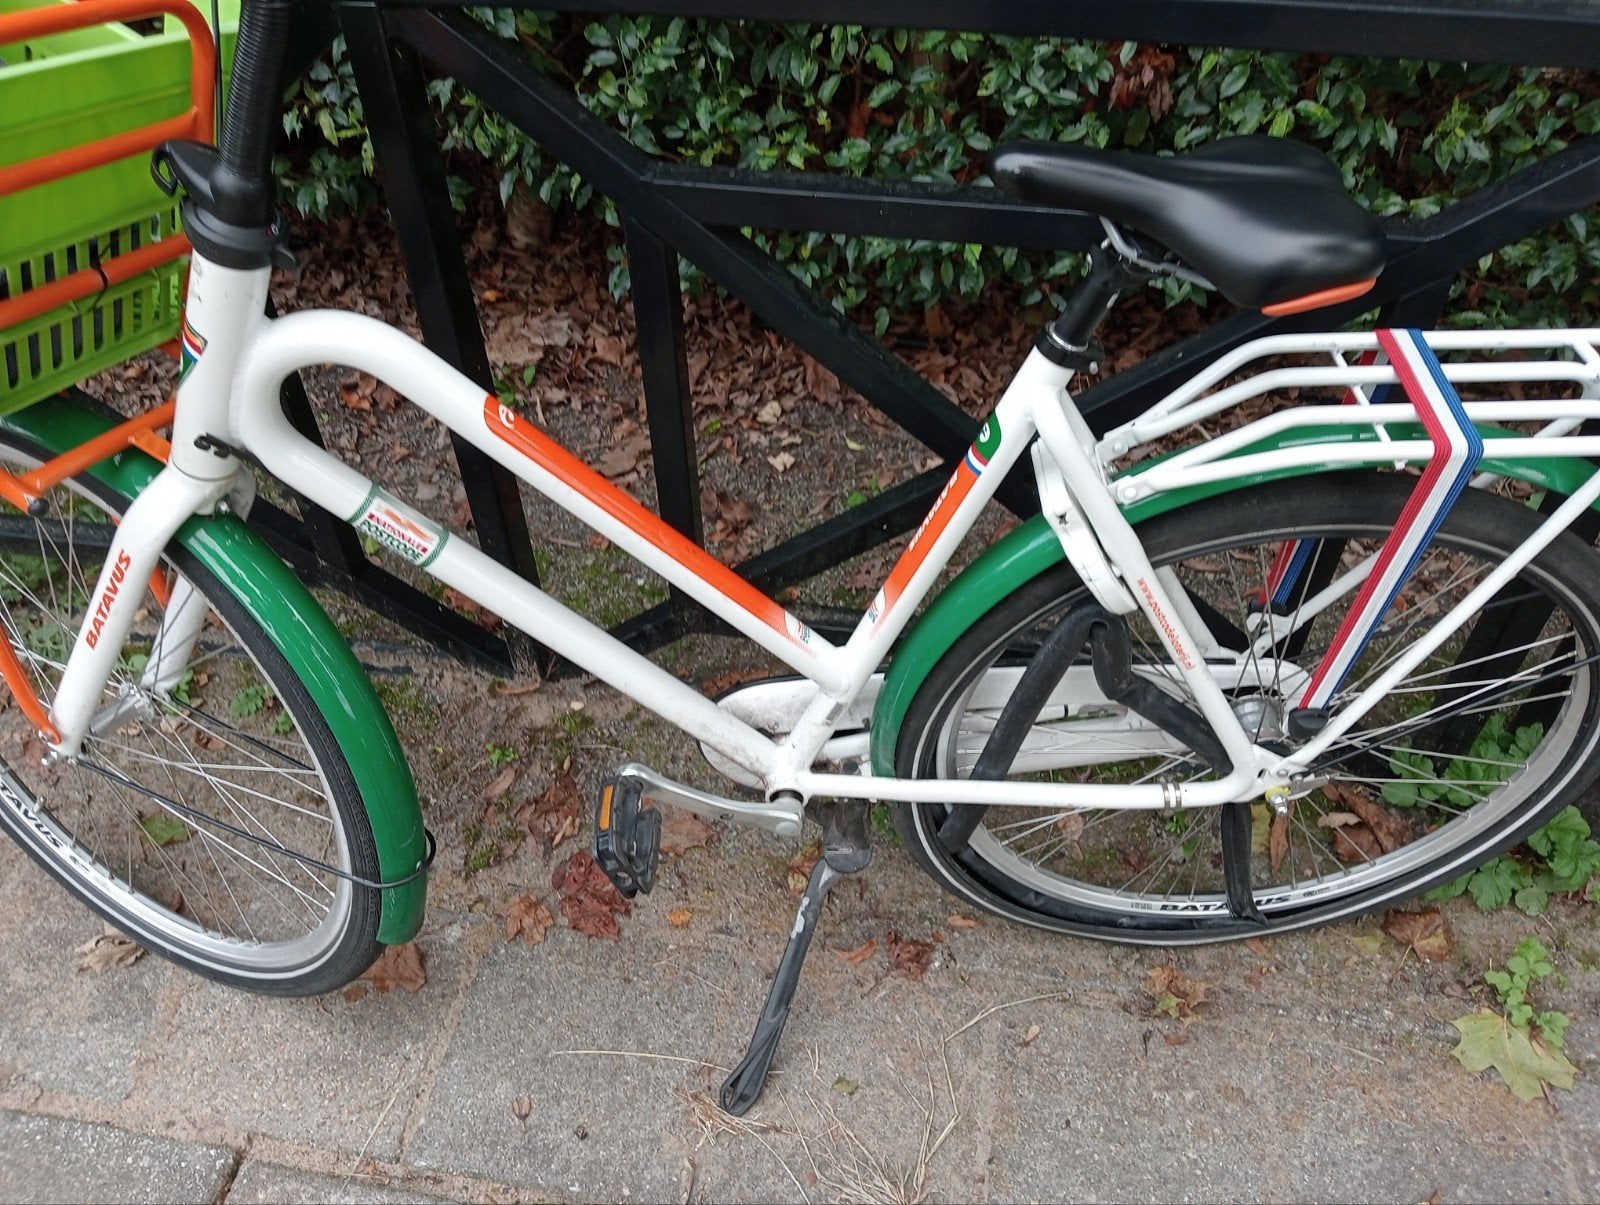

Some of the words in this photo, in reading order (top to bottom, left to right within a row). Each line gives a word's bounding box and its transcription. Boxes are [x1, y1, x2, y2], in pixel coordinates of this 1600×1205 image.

[361, 519, 424, 561] POSTCODE
[373, 516, 424, 551] NATIONALE
[85, 548, 131, 650] BATAVUS
[0, 781, 63, 848] TAVUS
[1160, 894, 1291, 911] BATAUS
